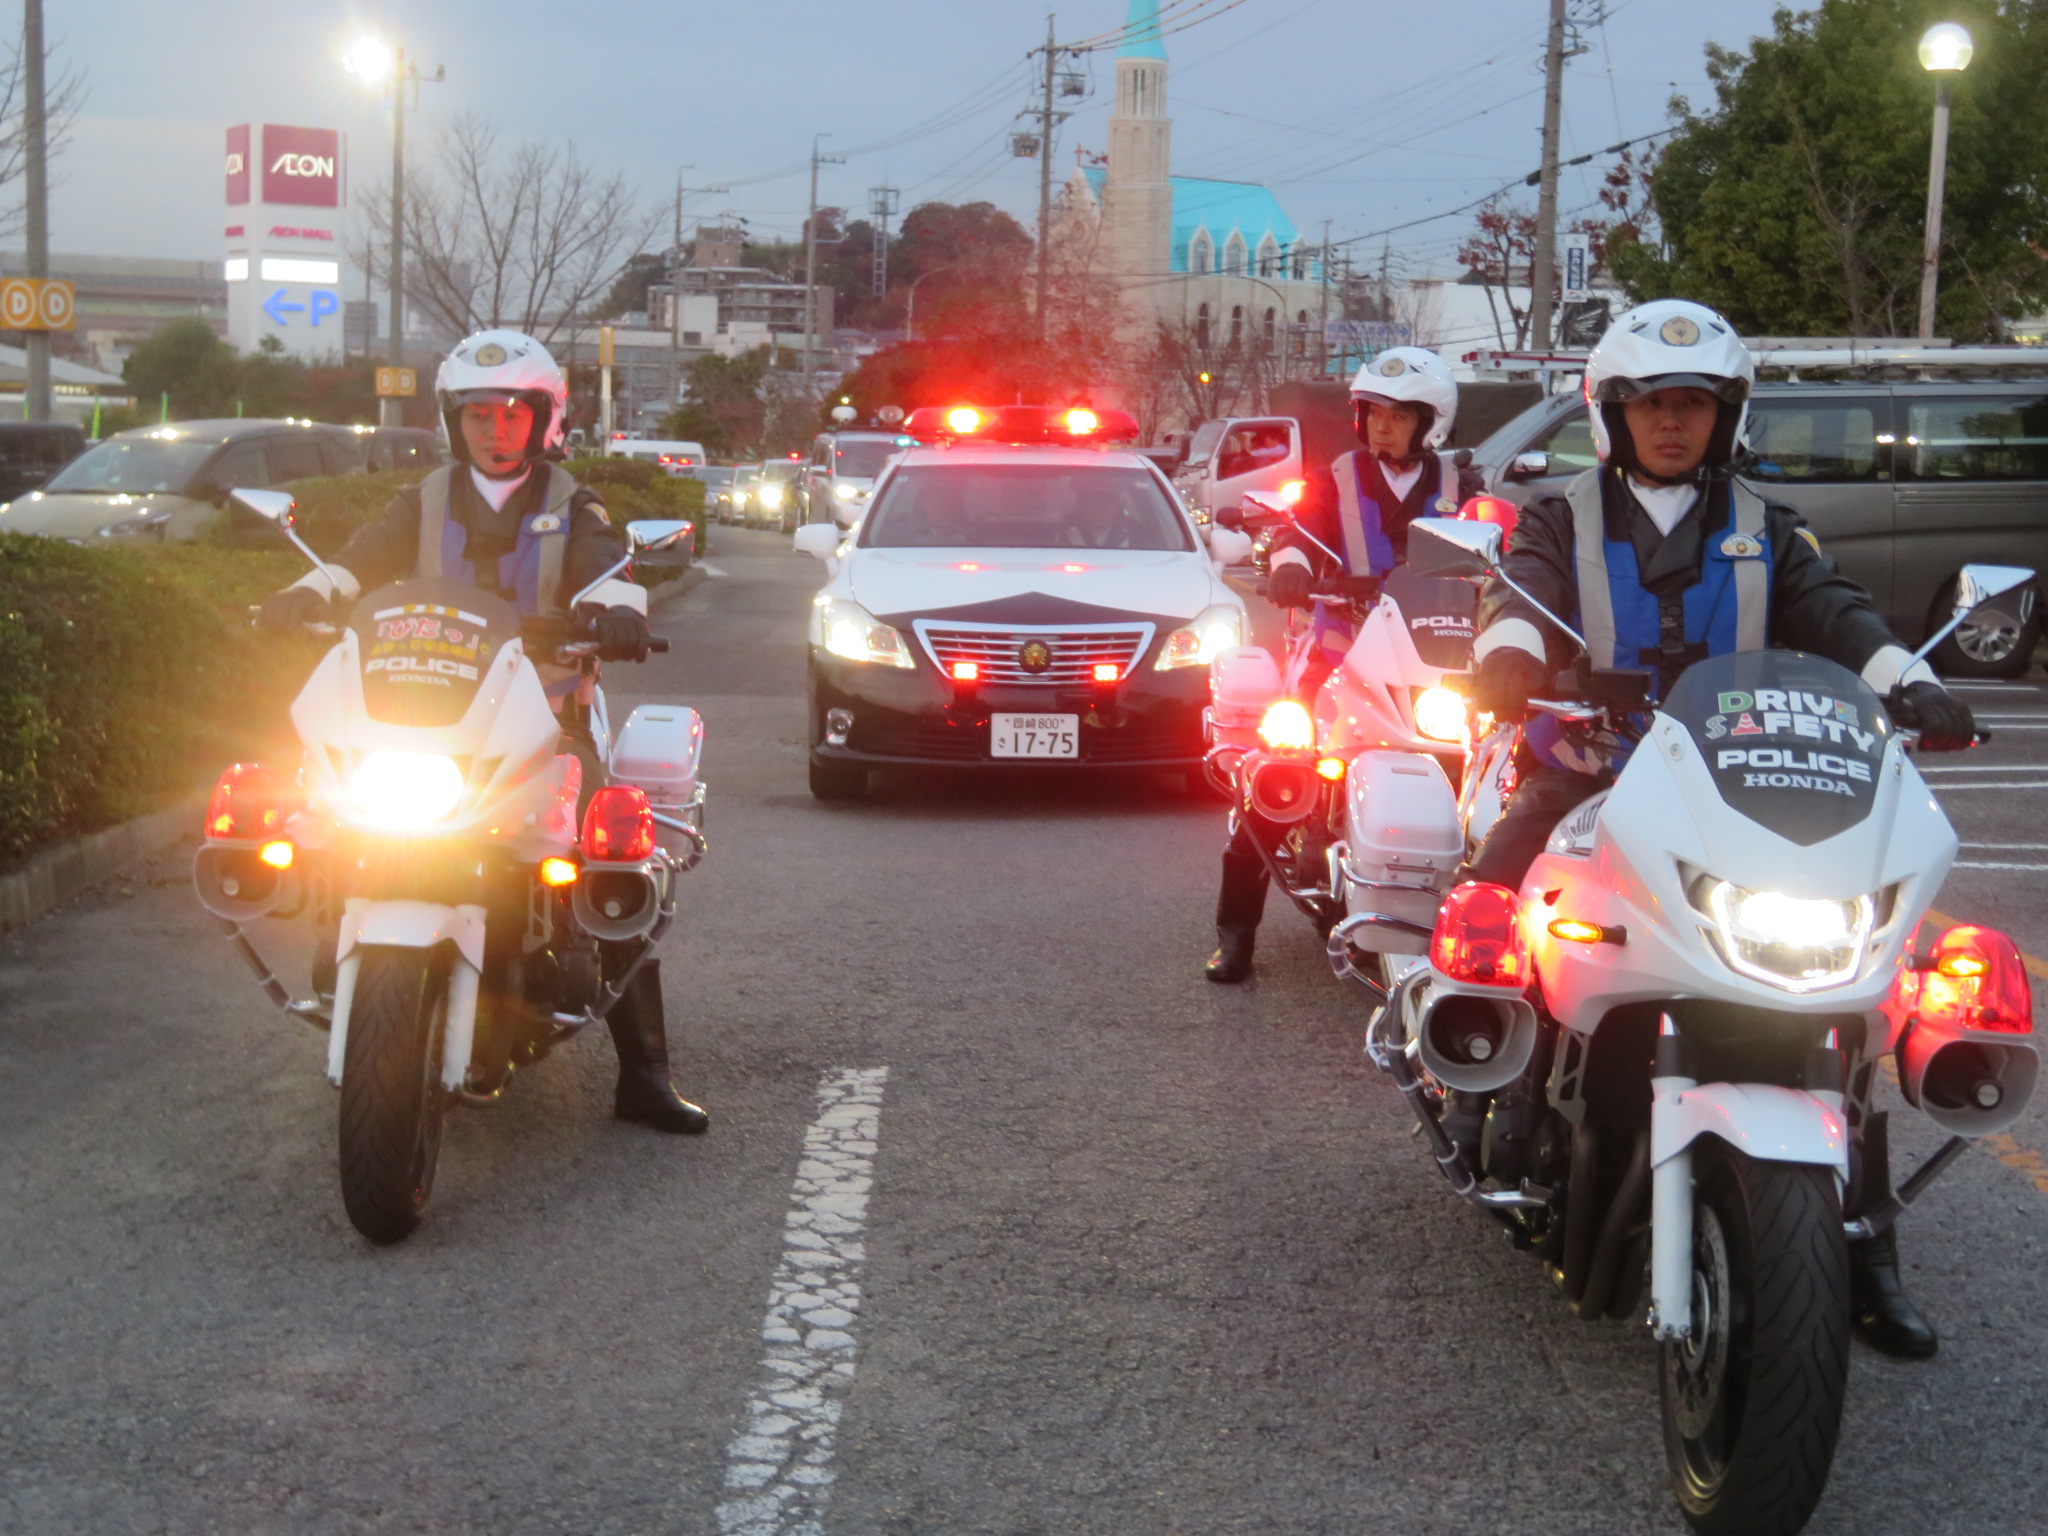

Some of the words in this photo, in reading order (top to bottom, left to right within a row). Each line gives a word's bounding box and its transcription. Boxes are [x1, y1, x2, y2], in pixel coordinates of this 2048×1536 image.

[12, 292, 27, 315] D
[49, 293, 65, 316] D
[311, 289, 338, 326] P
[1411, 615, 1473, 629] POLI
[1433, 628, 1473, 638] HOND
[365, 656, 479, 681] POLICE
[389, 674, 451, 687] HONDA
[1717, 689, 1859, 727] DRIVE
[1014, 732, 1073, 754] 17-75
[1705, 712, 1875, 752] SAFETY
[1717, 749, 1872, 782] POLICE
[1743, 773, 1856, 797] HONDA
